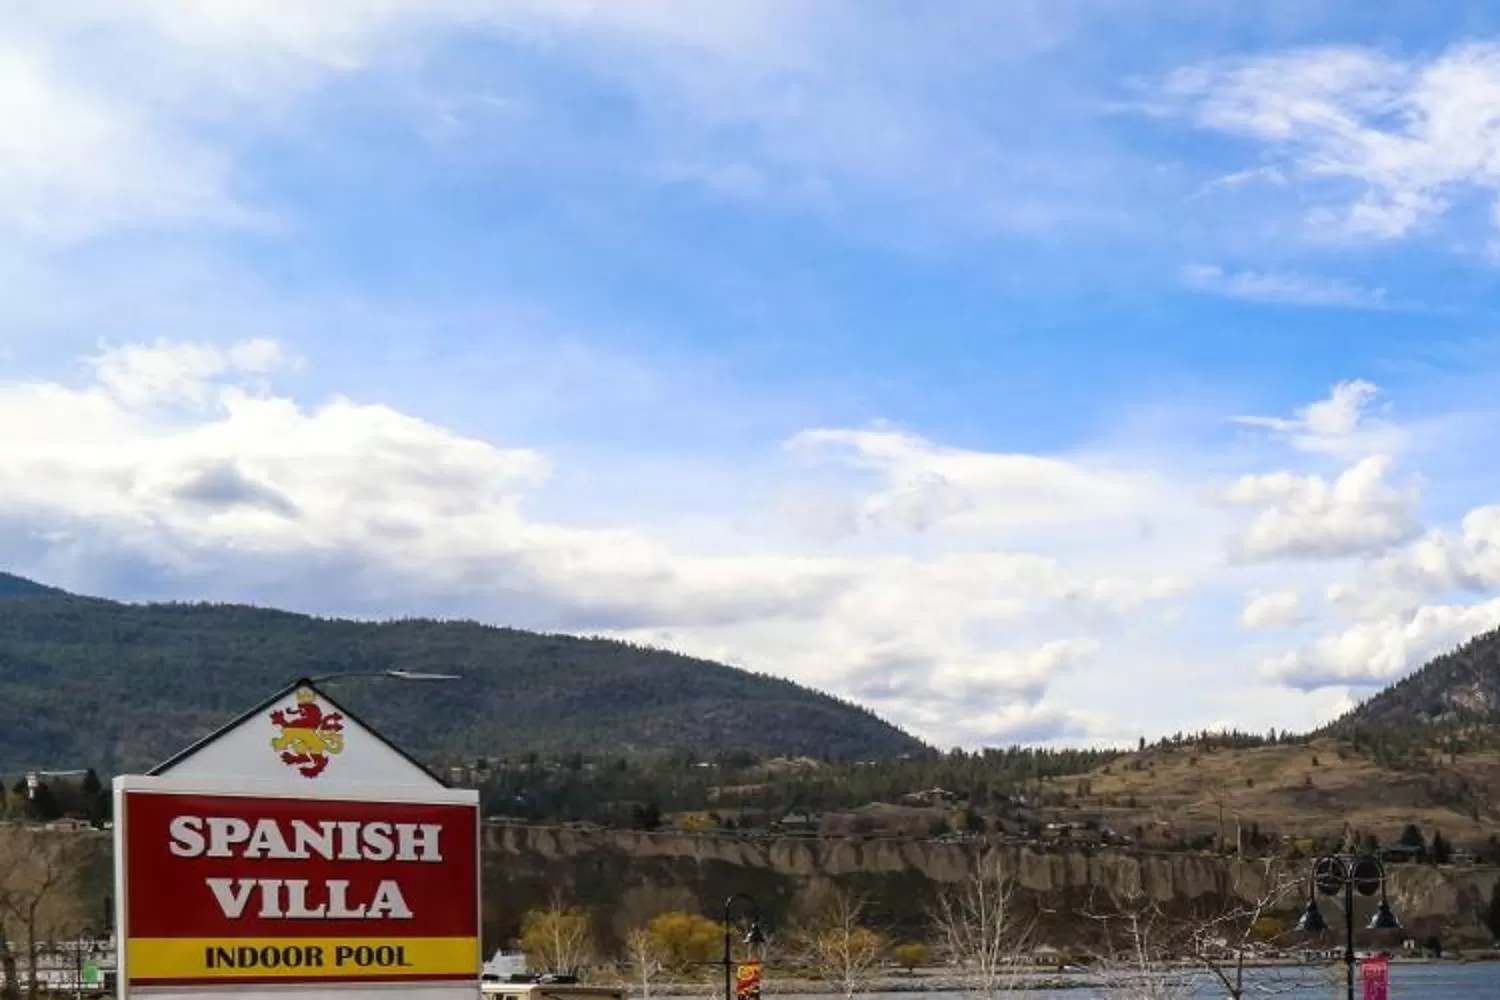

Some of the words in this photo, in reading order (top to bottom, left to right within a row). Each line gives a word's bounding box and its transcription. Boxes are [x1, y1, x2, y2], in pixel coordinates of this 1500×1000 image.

[169, 816, 442, 862] SPANISH
[206, 878, 414, 919] VILLA
[205, 945, 324, 969] INDOOR
[335, 945, 413, 968] POOL
